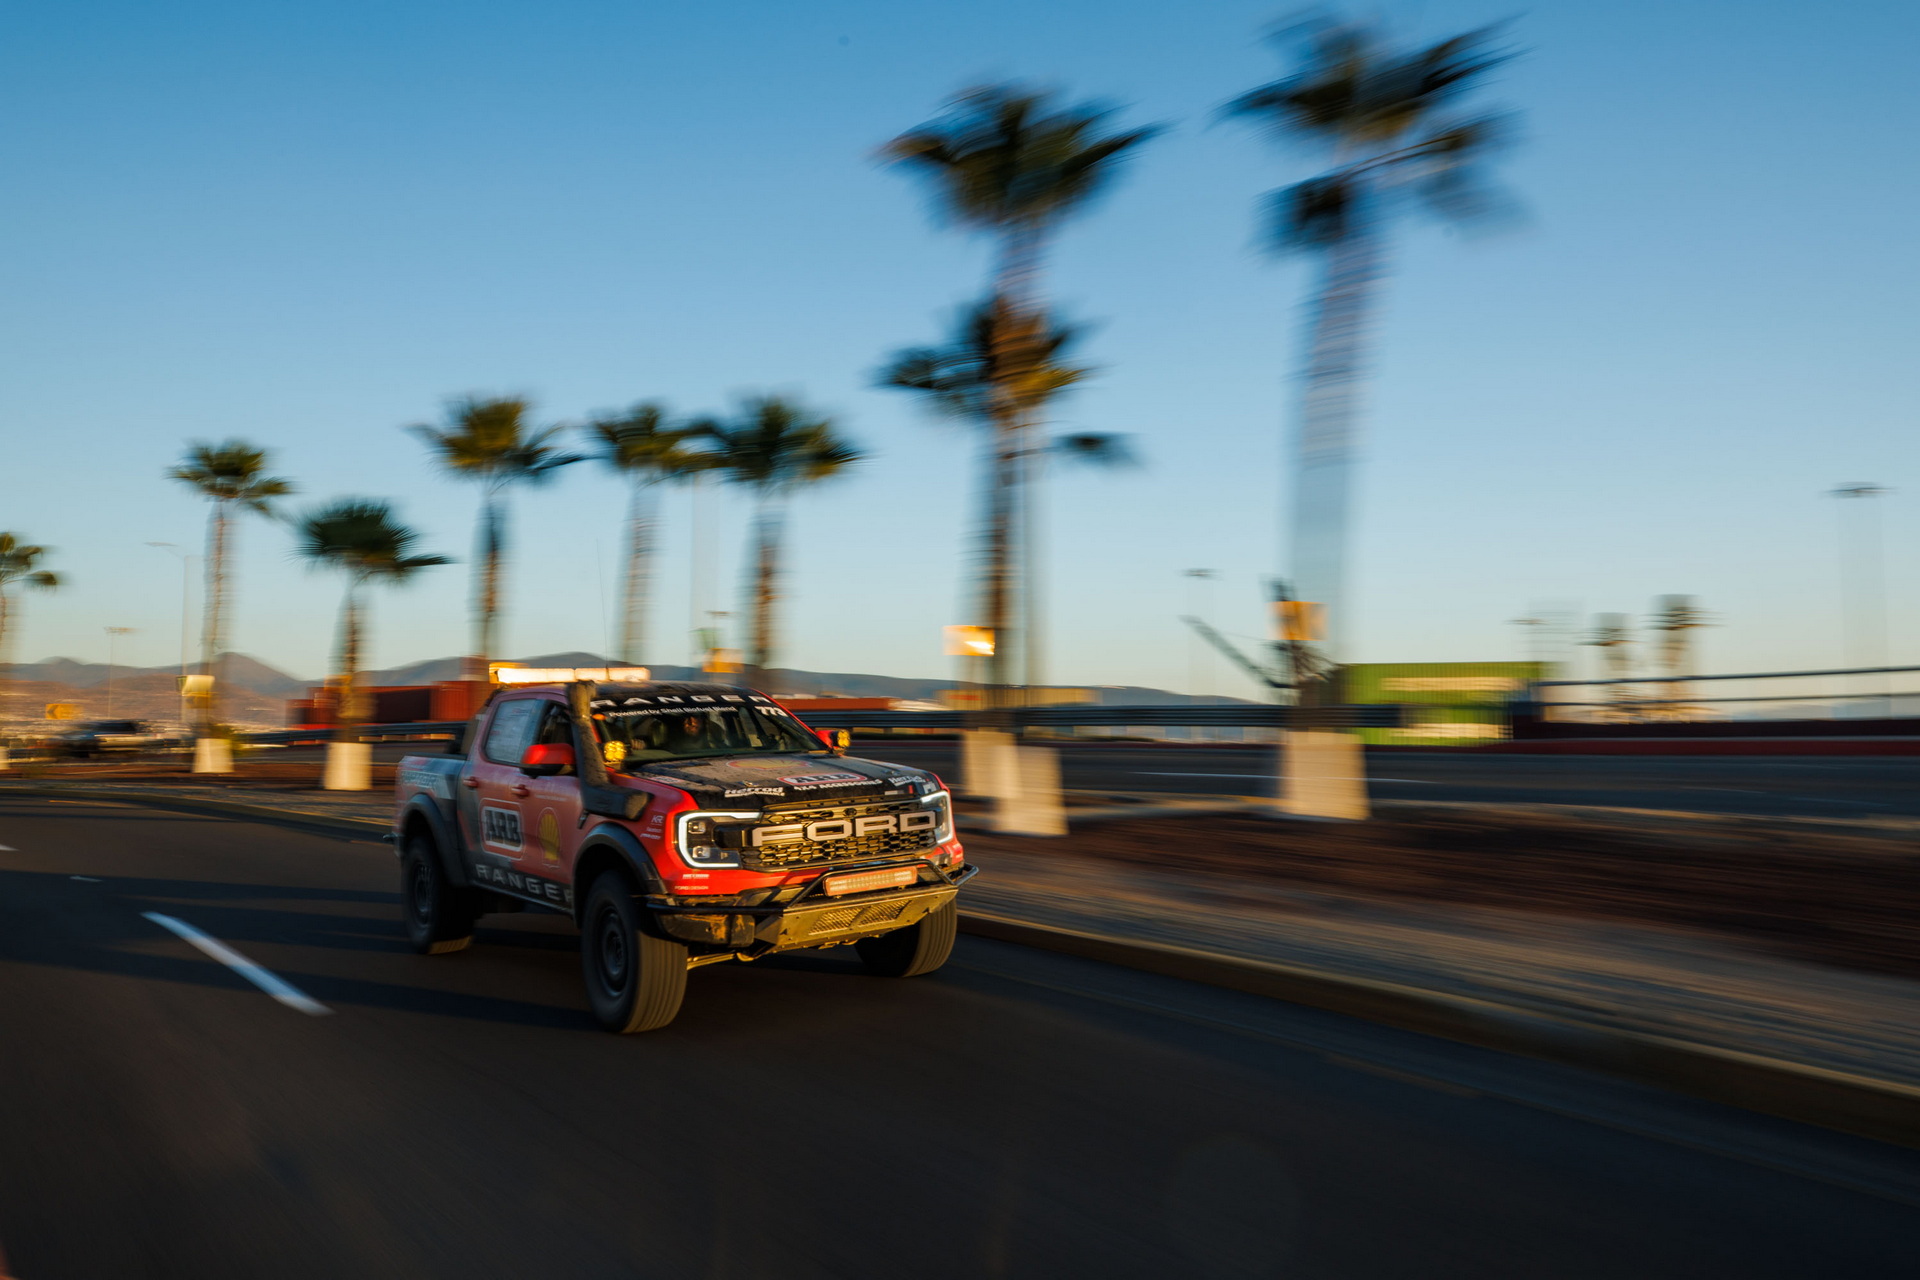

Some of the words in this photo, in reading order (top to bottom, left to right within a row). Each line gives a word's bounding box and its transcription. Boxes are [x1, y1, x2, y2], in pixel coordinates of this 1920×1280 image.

[609, 709, 649, 717] Powered
[754, 705, 789, 717] 773
[794, 773, 857, 783] ARB
[819, 779, 883, 789] ACCESSORIES
[725, 787, 784, 795] Herrod
[484, 809, 522, 846] ARB
[752, 811, 936, 847] FORD
